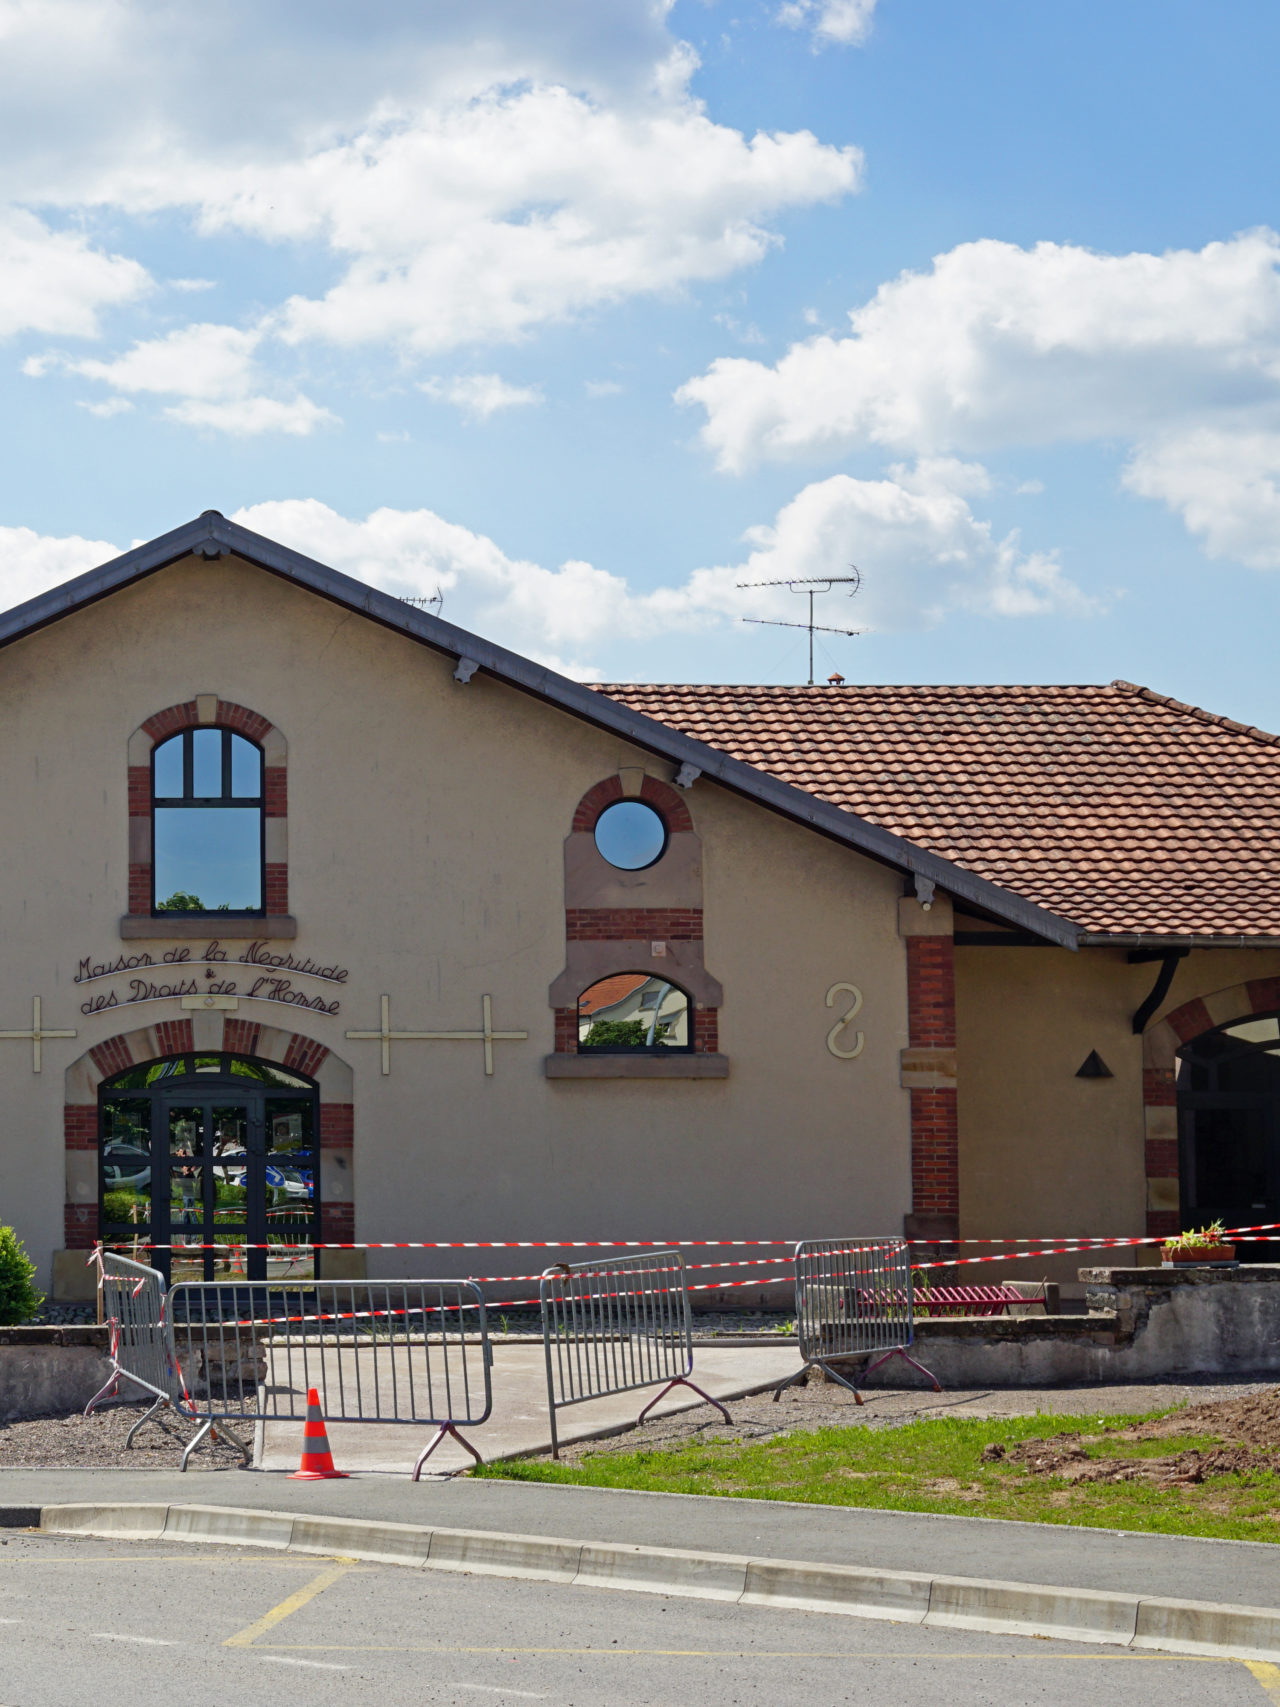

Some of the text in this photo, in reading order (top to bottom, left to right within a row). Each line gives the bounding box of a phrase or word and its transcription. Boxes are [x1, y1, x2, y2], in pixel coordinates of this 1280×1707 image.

[73, 952, 157, 983] Maison
[163, 947, 191, 963] de
[201, 940, 227, 962] la
[205, 968, 217, 979] &
[80, 976, 340, 1016] des Droits de l'Homme
